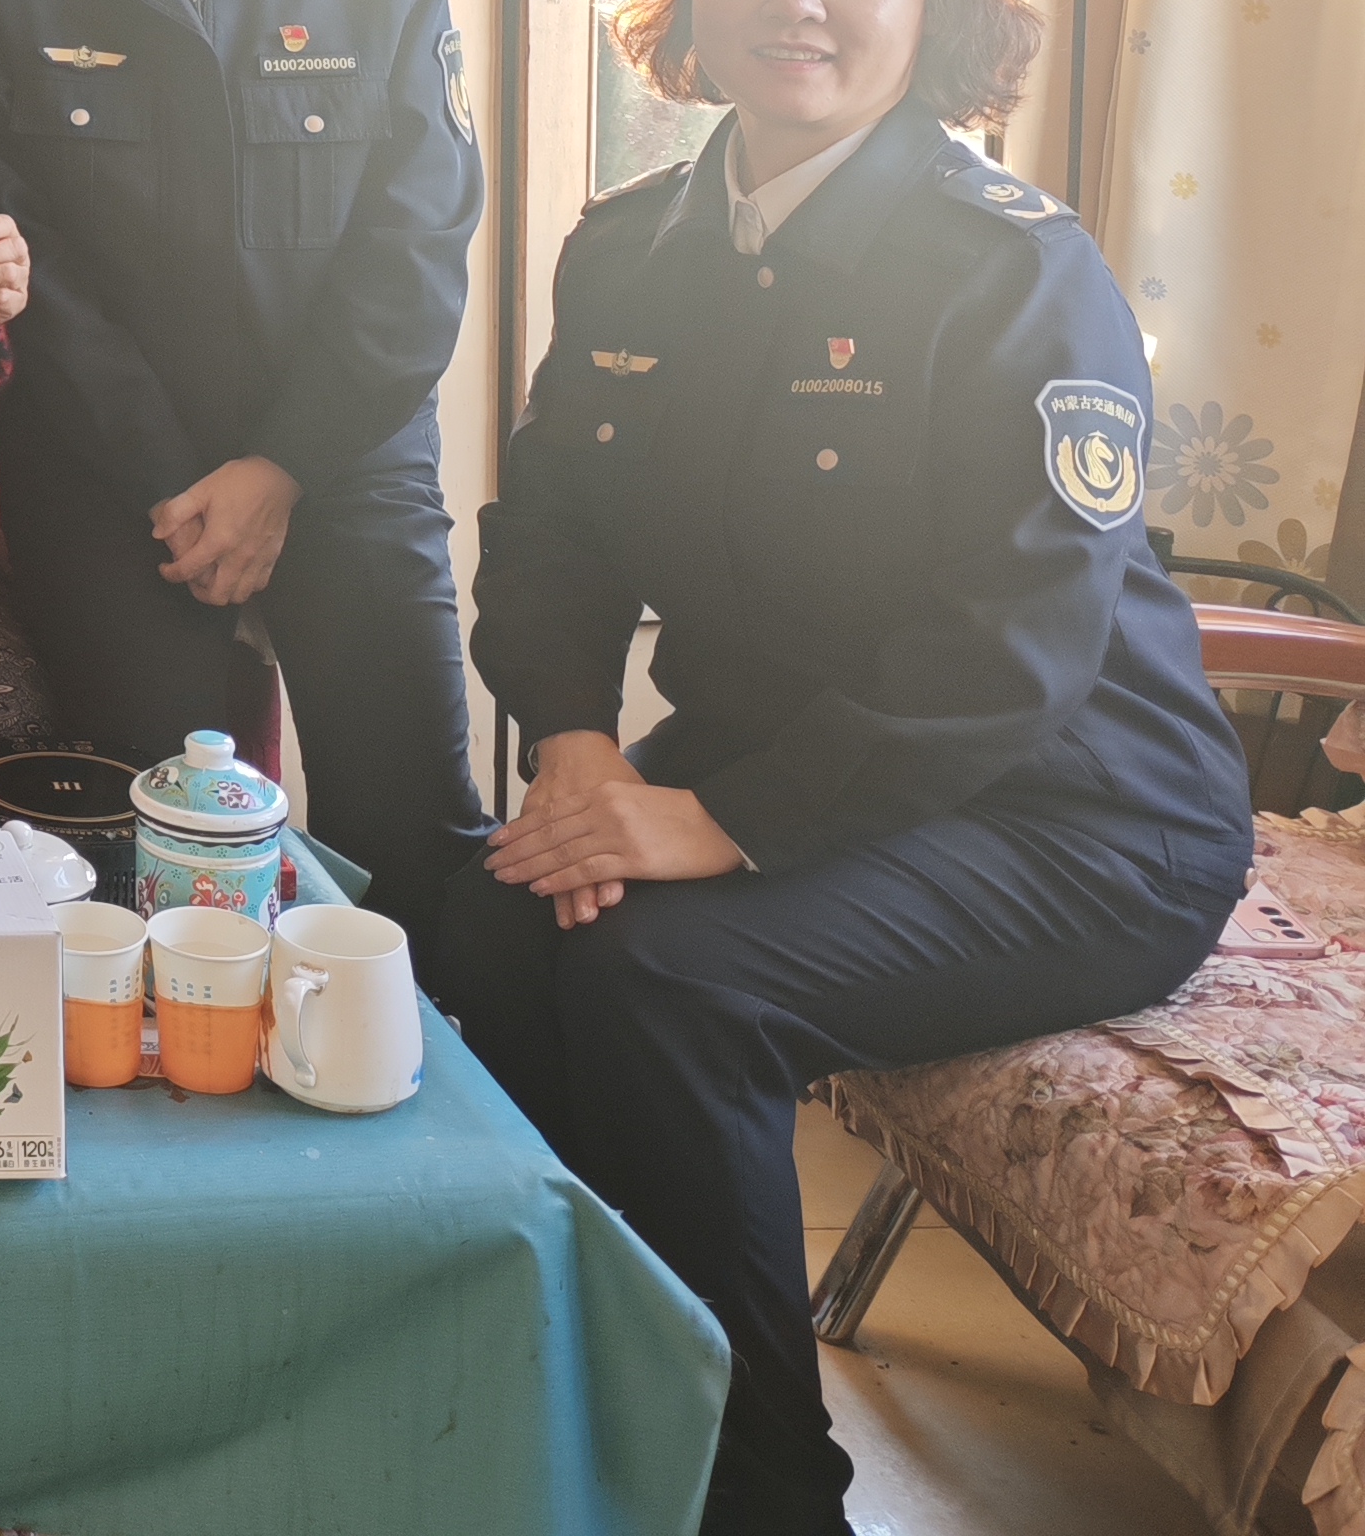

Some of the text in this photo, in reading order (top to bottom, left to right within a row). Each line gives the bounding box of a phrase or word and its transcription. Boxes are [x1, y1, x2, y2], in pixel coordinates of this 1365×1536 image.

[263, 57, 356, 72] 01002008006
[791, 378, 884, 396] 01002008015
[1051, 394, 1136, 428] 内蒙古交通集团
[21, 1140, 47, 1158] 120
